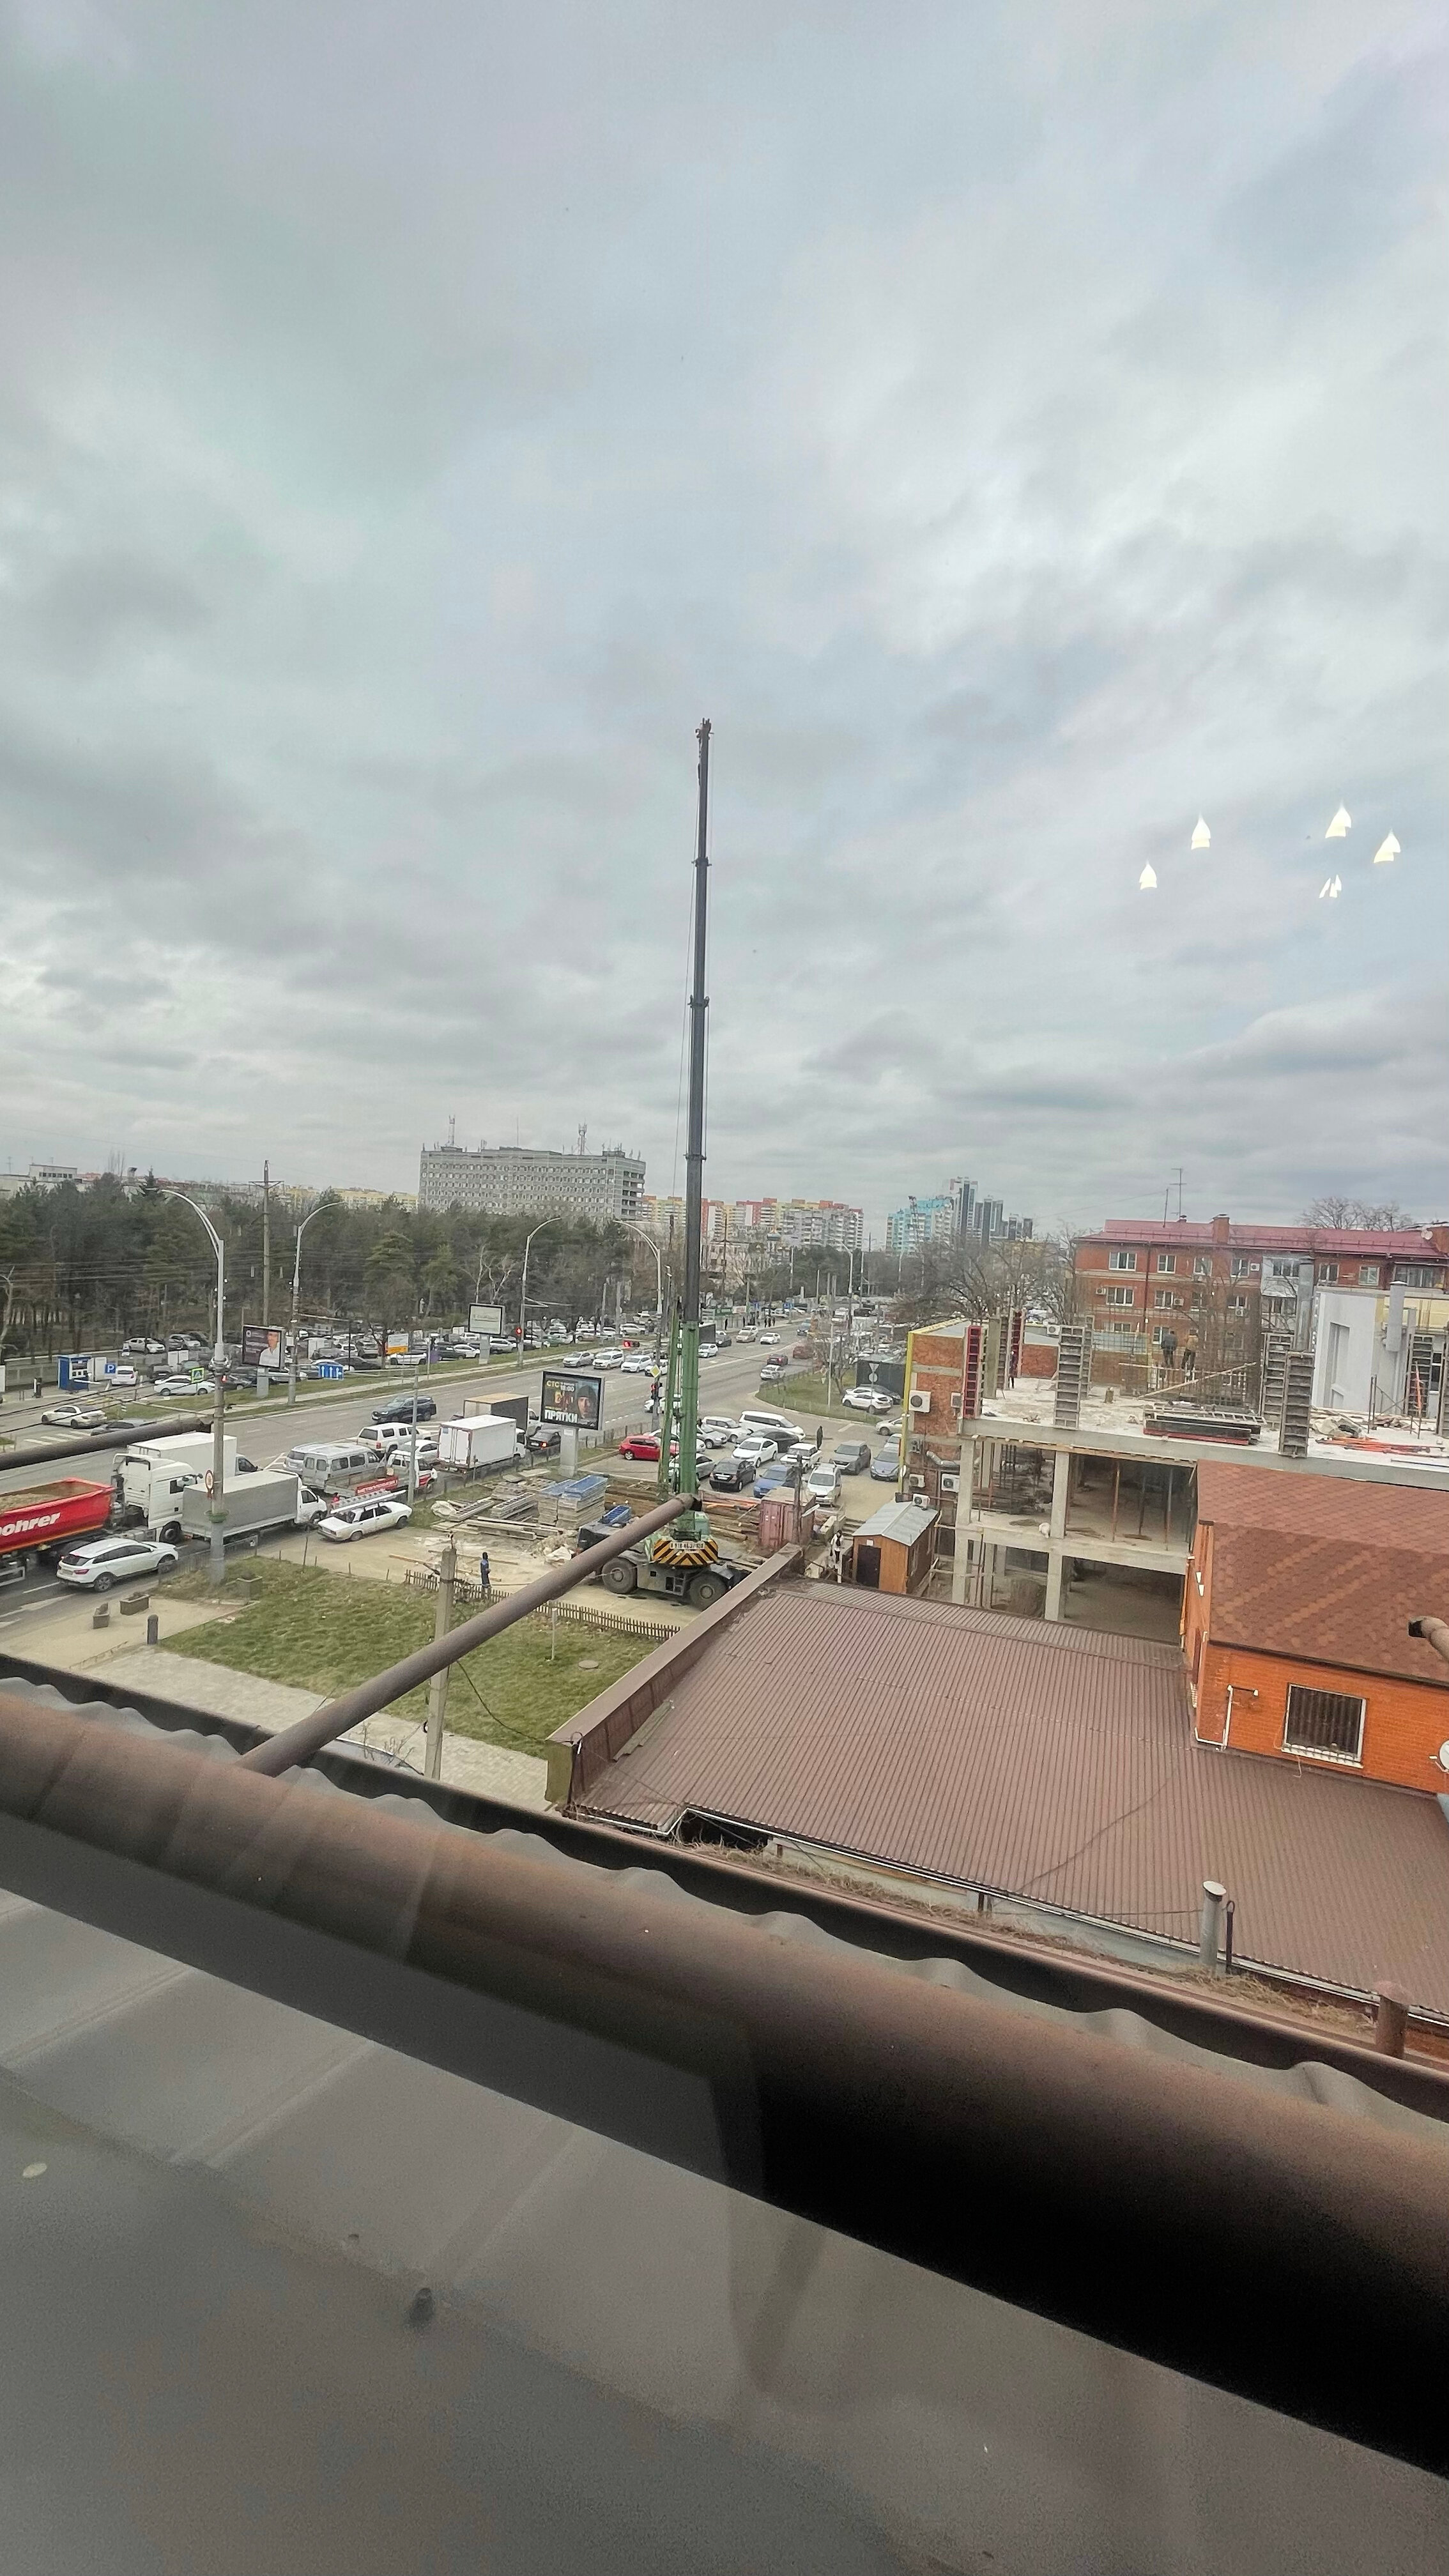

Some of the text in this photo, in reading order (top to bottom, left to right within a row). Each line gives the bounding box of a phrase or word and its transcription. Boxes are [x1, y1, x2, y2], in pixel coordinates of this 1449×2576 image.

[107, 1364, 114, 1373] P
[544, 1409, 578, 1423] ПРЯТКИ
[0, 1512, 61, 1536] ohrer
